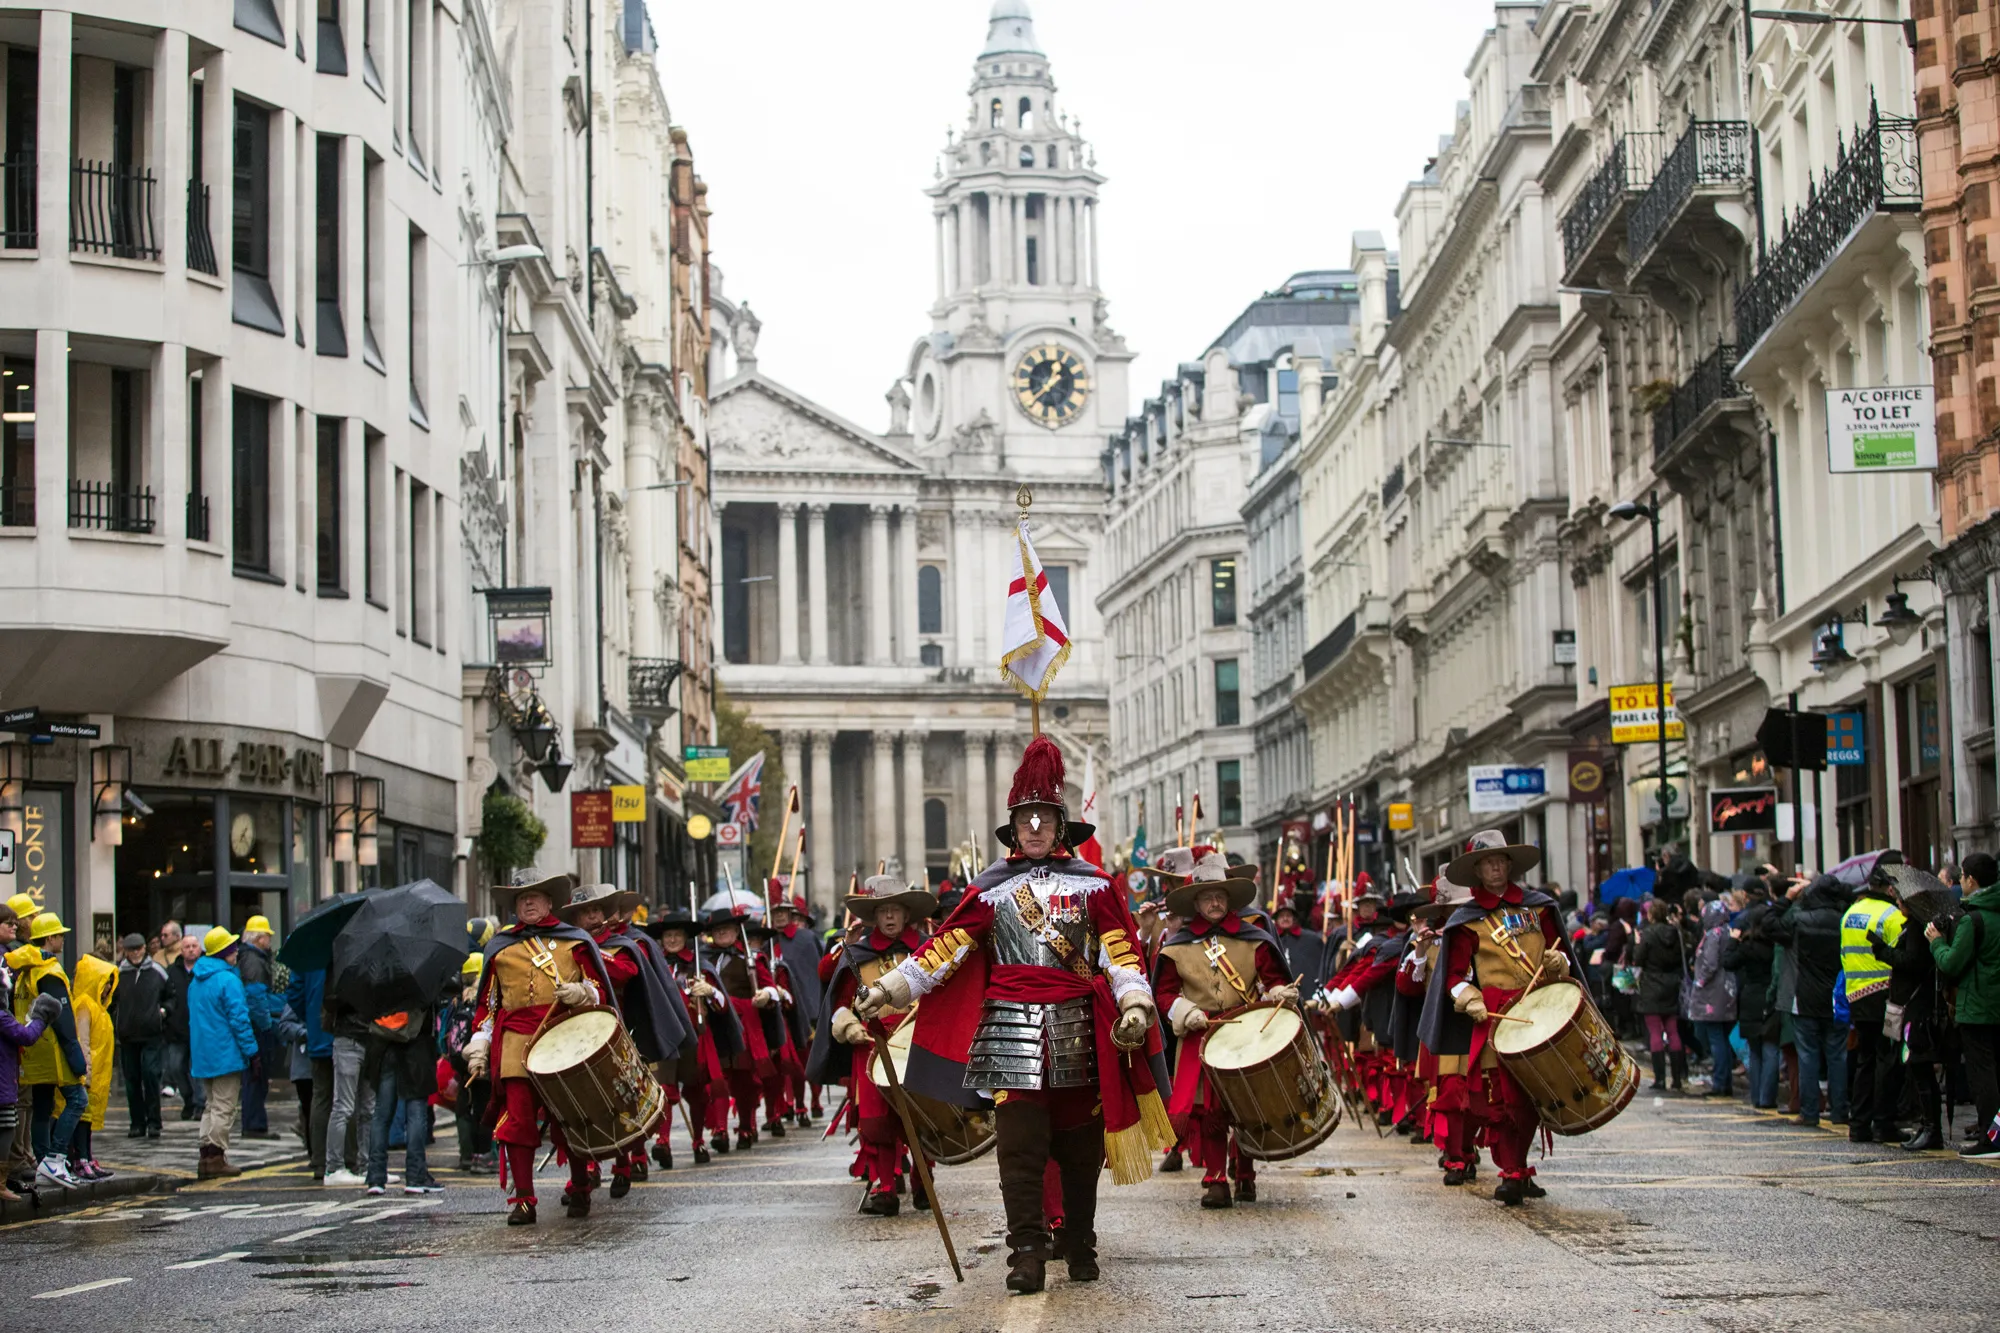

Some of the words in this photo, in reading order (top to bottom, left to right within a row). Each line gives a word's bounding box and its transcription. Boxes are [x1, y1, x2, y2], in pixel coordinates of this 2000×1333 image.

[1842, 392, 1868, 406] A/C
[1873, 390, 1922, 402] OFFICE
[1853, 407, 1876, 420] TO
[1882, 406, 1911, 419] LET
[1615, 696, 1638, 709] TO
[1645, 692, 1675, 707] LT
[1613, 713, 1639, 723] PEARL
[50, 725, 77, 734] Blackfriars
[78, 727, 97, 735] Station
[1827, 750, 1860, 761] REGGS
[614, 795, 640, 809] itsu
[25, 805, 45, 872] ONE
